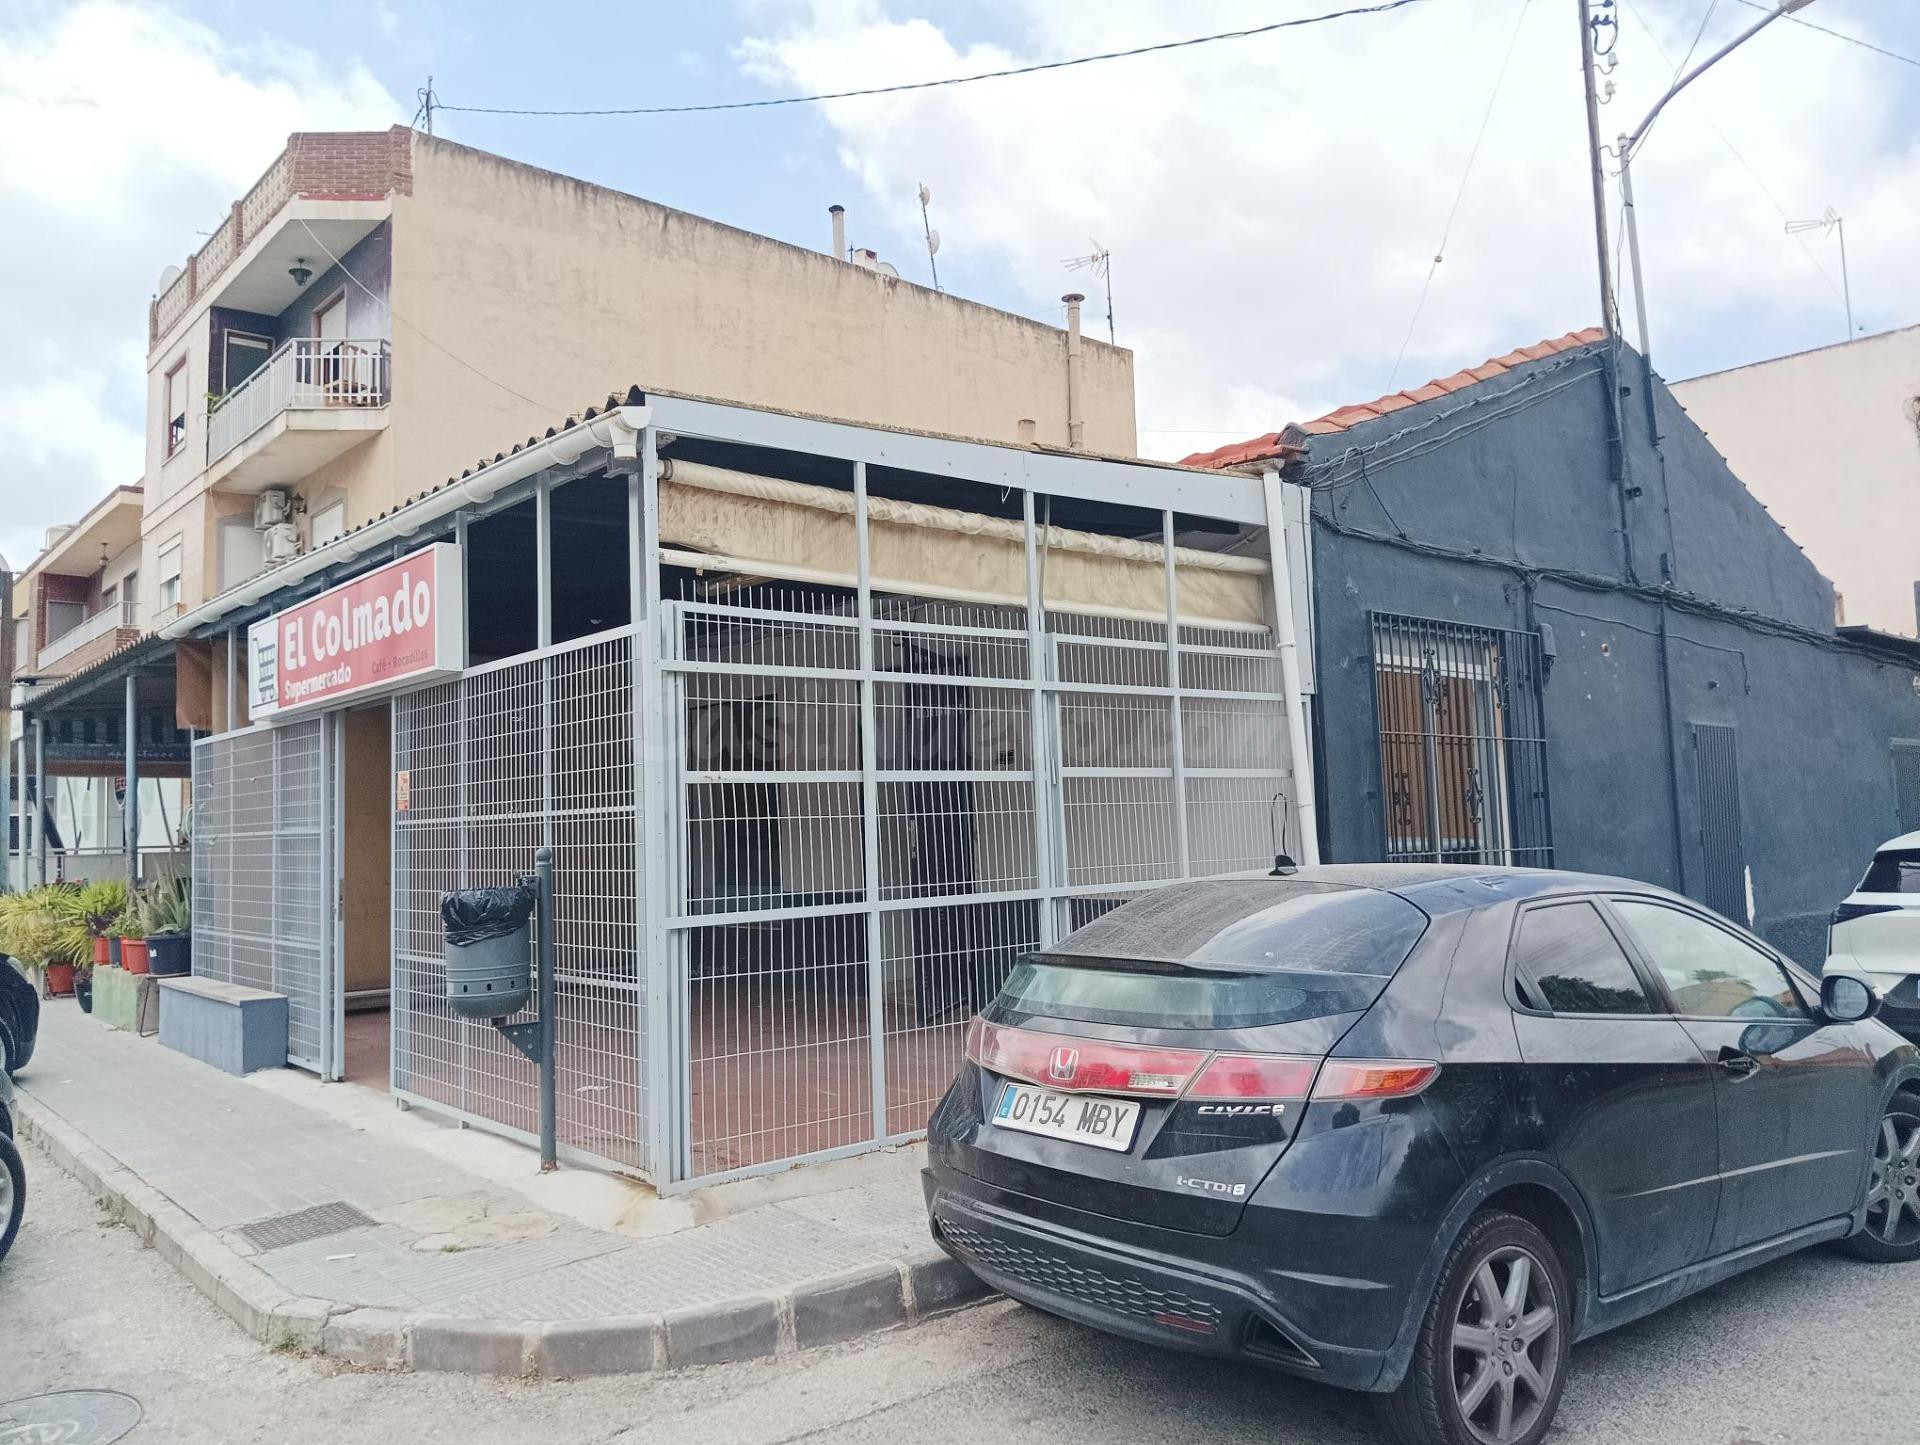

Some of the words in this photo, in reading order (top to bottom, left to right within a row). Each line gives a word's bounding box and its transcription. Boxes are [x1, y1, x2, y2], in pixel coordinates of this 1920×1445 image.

[286, 616, 307, 671] El
[313, 571, 431, 662] Colmado
[284, 661, 351, 703] Supermercado
[1012, 1092, 1069, 1128] 0154
[1076, 1101, 1129, 1138] MBY
